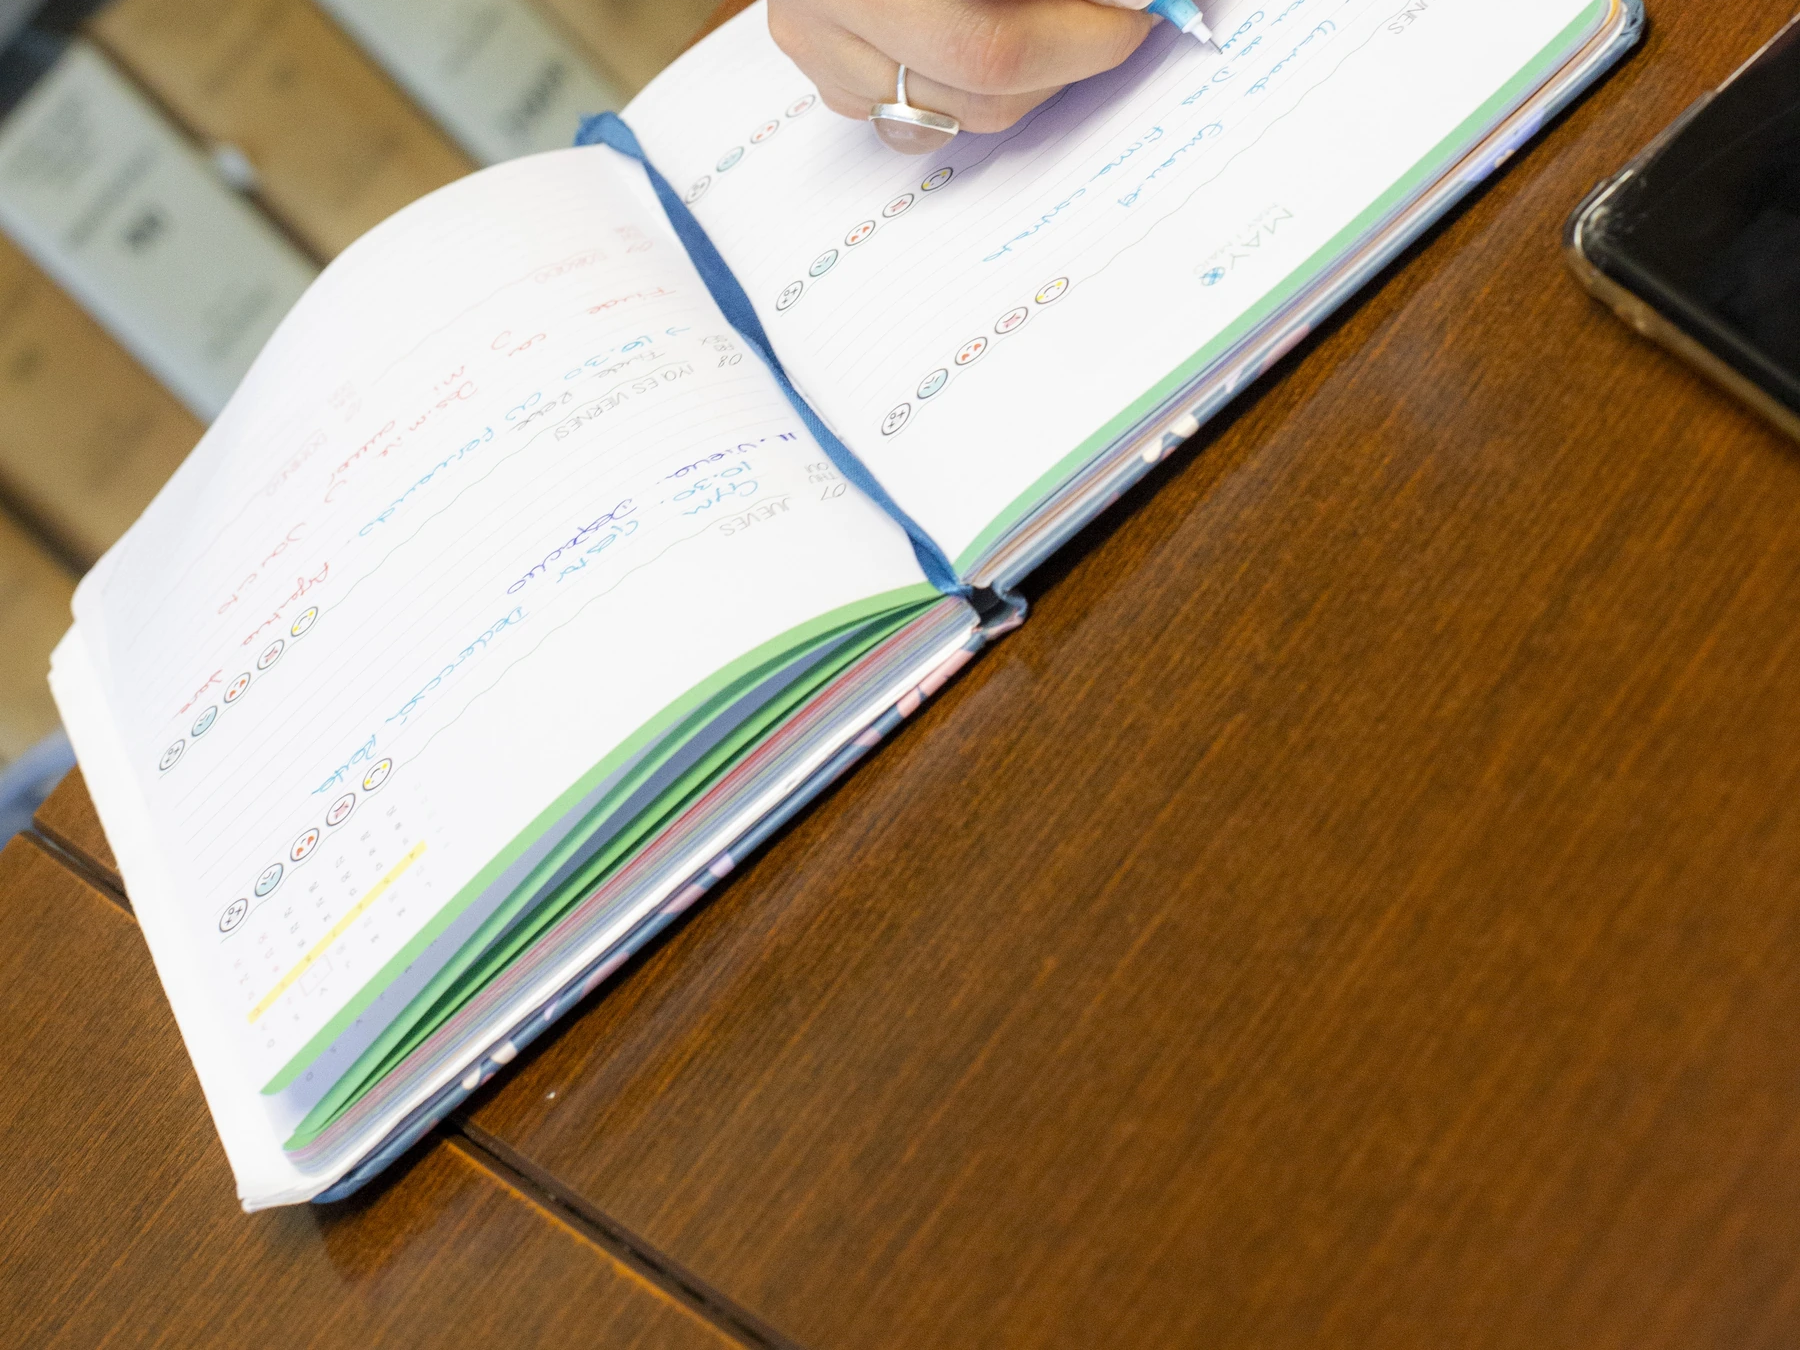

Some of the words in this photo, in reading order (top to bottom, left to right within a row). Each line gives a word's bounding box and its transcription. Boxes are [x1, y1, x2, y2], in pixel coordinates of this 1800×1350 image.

[717, 353, 743, 368] 08
[631, 376, 659, 395] ES
[548, 391, 629, 442] VIERNES!
[804, 456, 830, 480] QUI
[808, 464, 839, 484] THU
[820, 477, 848, 501] 07
[718, 493, 790, 537] JUEVES
